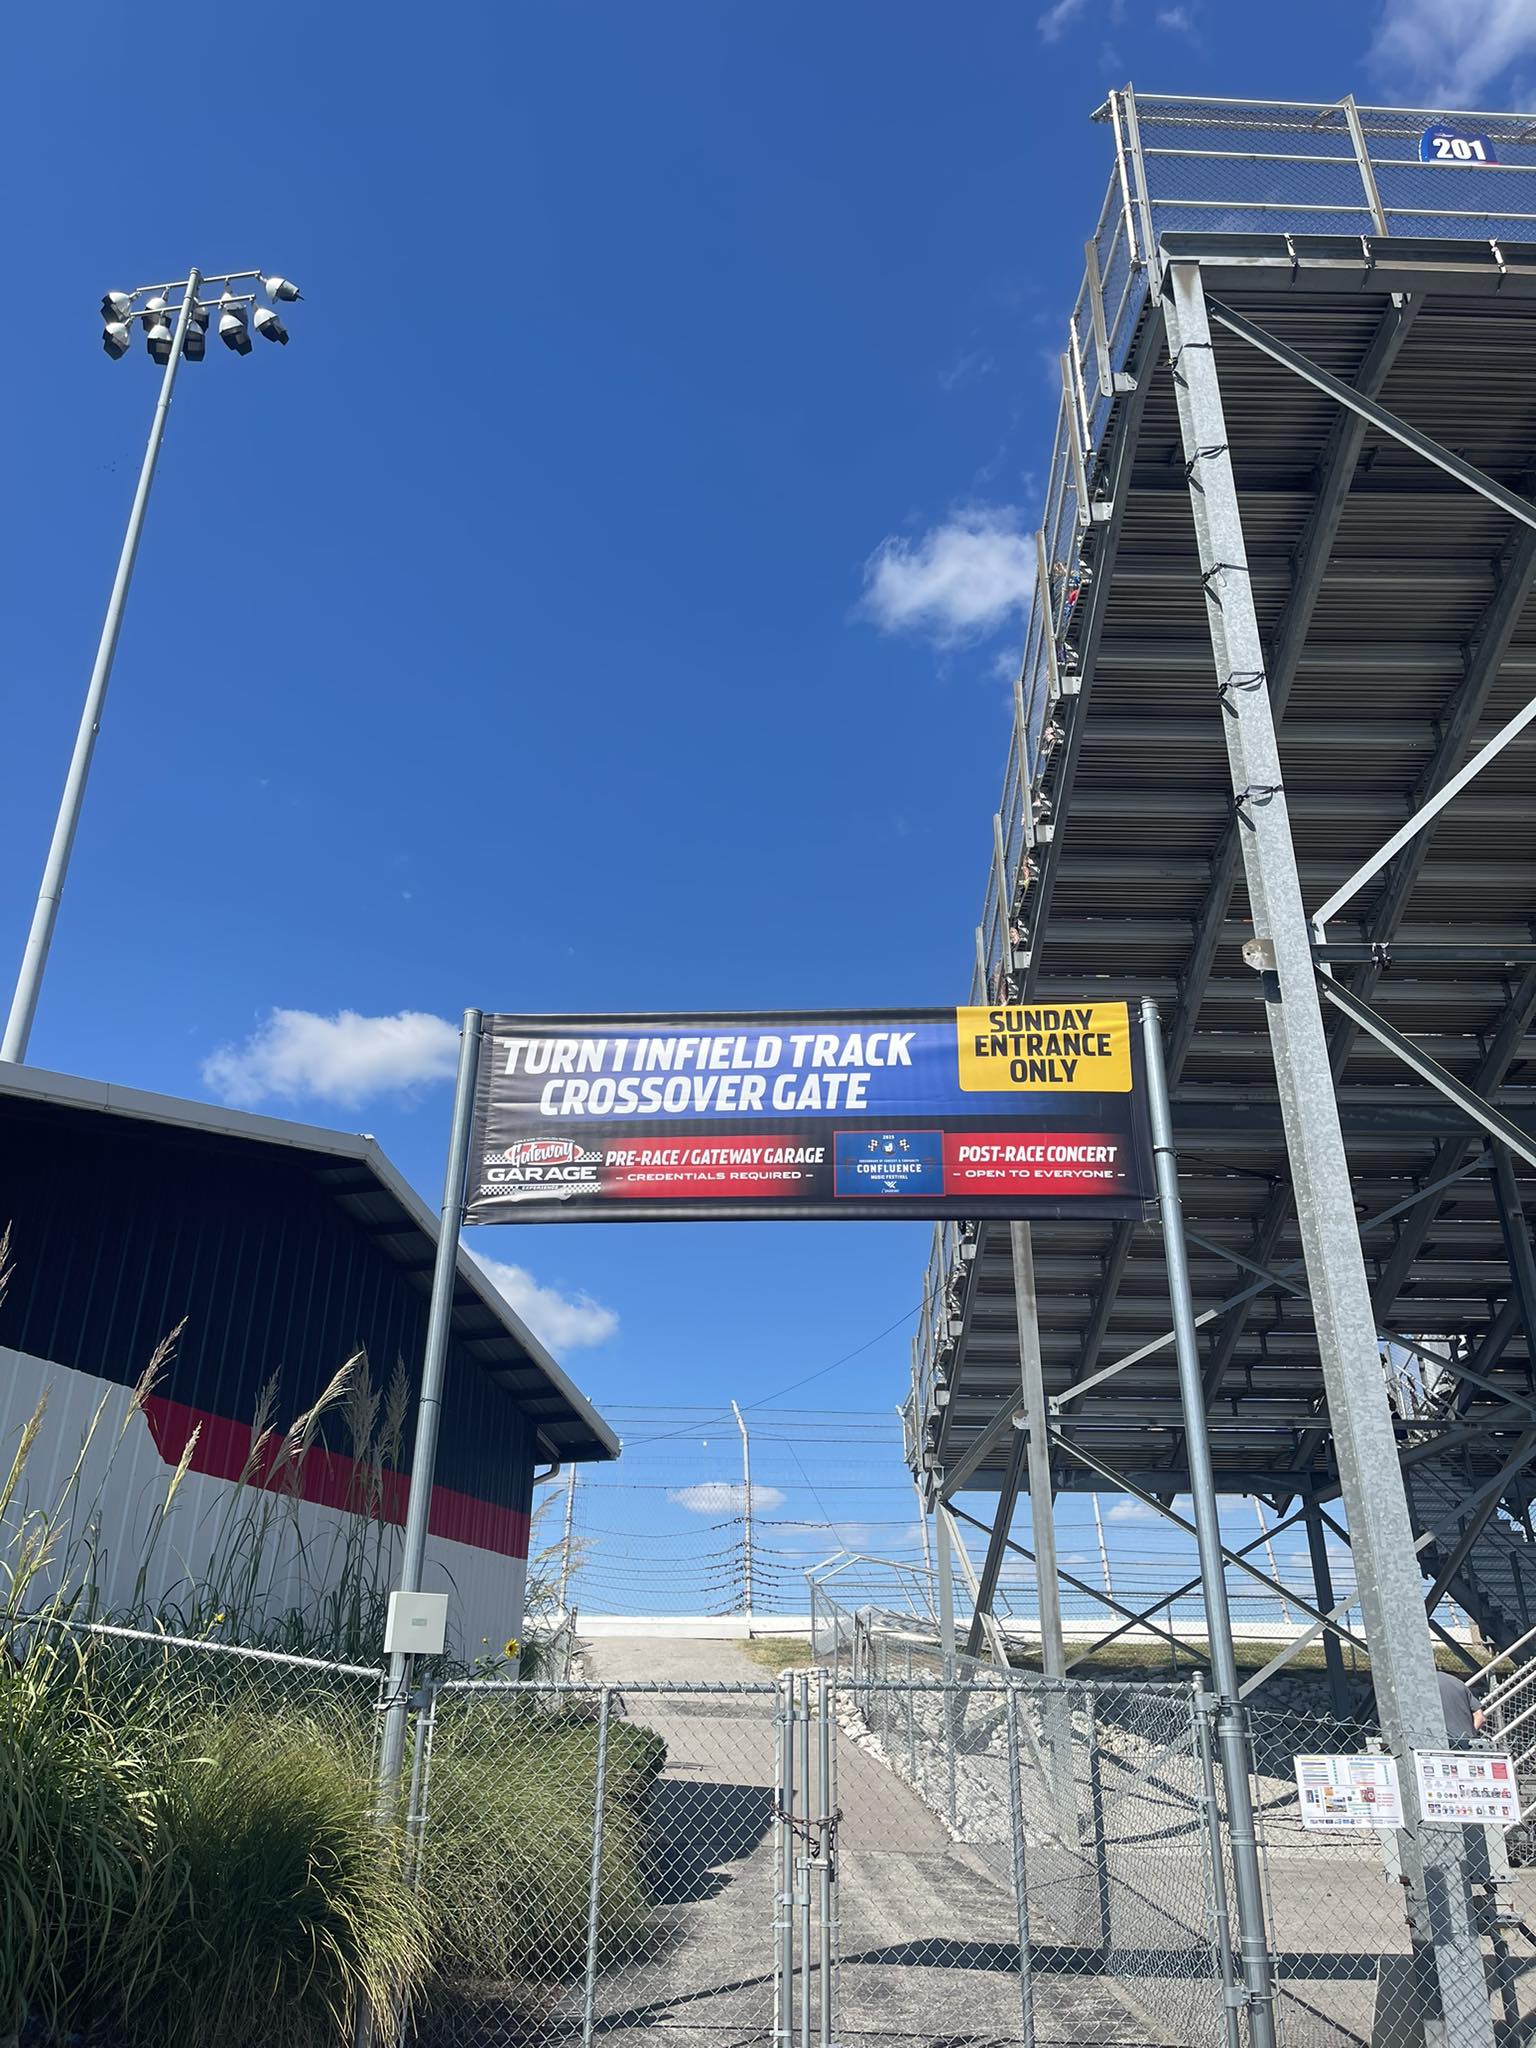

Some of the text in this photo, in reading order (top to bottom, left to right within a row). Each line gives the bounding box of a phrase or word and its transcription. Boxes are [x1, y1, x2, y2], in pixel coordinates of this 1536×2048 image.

[1432, 138, 1486, 160] 201
[989, 1009, 1093, 1033] SUNDAY
[503, 1033, 916, 1075] TURN 1 INFIELD TRACK
[974, 1033, 1112, 1057] ENTRANCE
[1010, 1059, 1078, 1083] ONLY
[540, 1072, 871, 1116] CROSSOVER GATE
[511, 1142, 573, 1167] Gateway
[605, 1149, 679, 1167] PRE-RACE
[691, 1148, 763, 1165] GATEWAY
[764, 1147, 825, 1164] GARAGE
[958, 1146, 1118, 1163] POST-RACE CONCERT
[487, 1166, 597, 1182] GARAGE
[627, 1172, 725, 1181] CREDENTIALS
[729, 1171, 802, 1181] REQUIRED
[857, 1163, 922, 1174] CONFLUENCE
[965, 1170, 1006, 1178] OPEN
[1009, 1170, 1030, 1178] TO
[1034, 1170, 1113, 1178] EVERYONE
